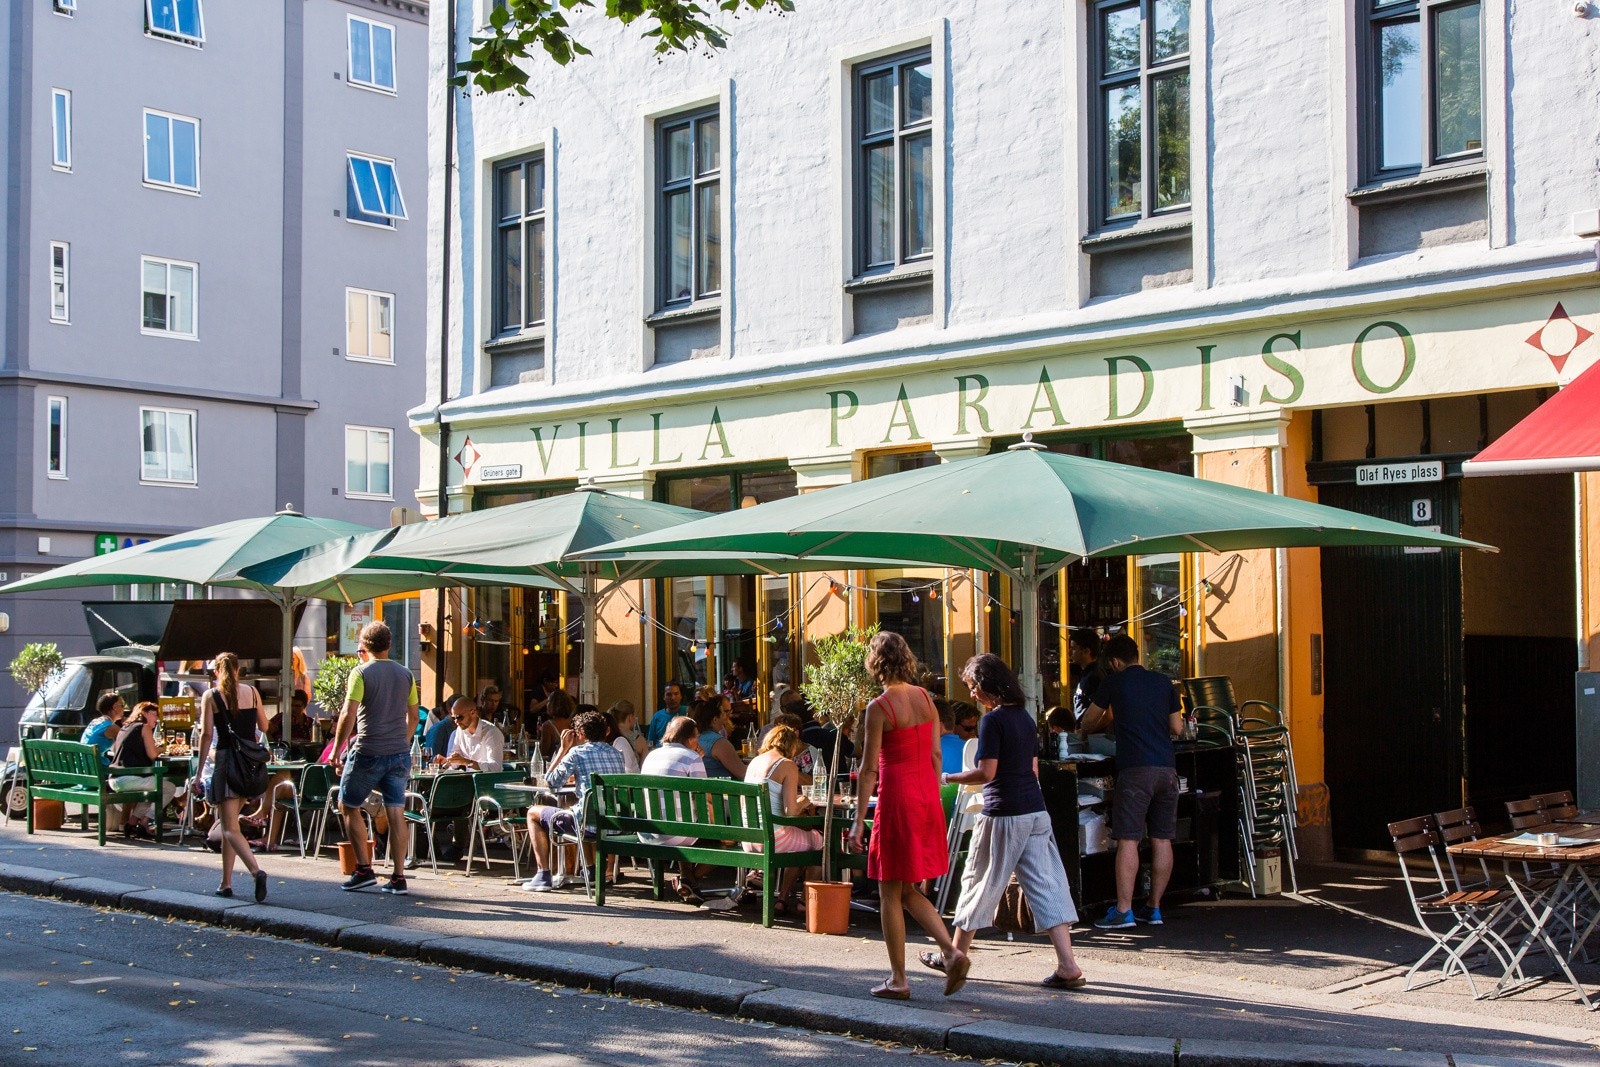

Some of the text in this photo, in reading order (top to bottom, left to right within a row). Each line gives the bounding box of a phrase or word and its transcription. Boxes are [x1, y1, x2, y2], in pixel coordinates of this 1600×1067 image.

[529, 321, 1416, 476] VILLA PARADISO
[505, 467, 518, 478] gate
[1360, 465, 1438, 481] Olaf Ryes plass
[1416, 501, 1427, 518] 8
